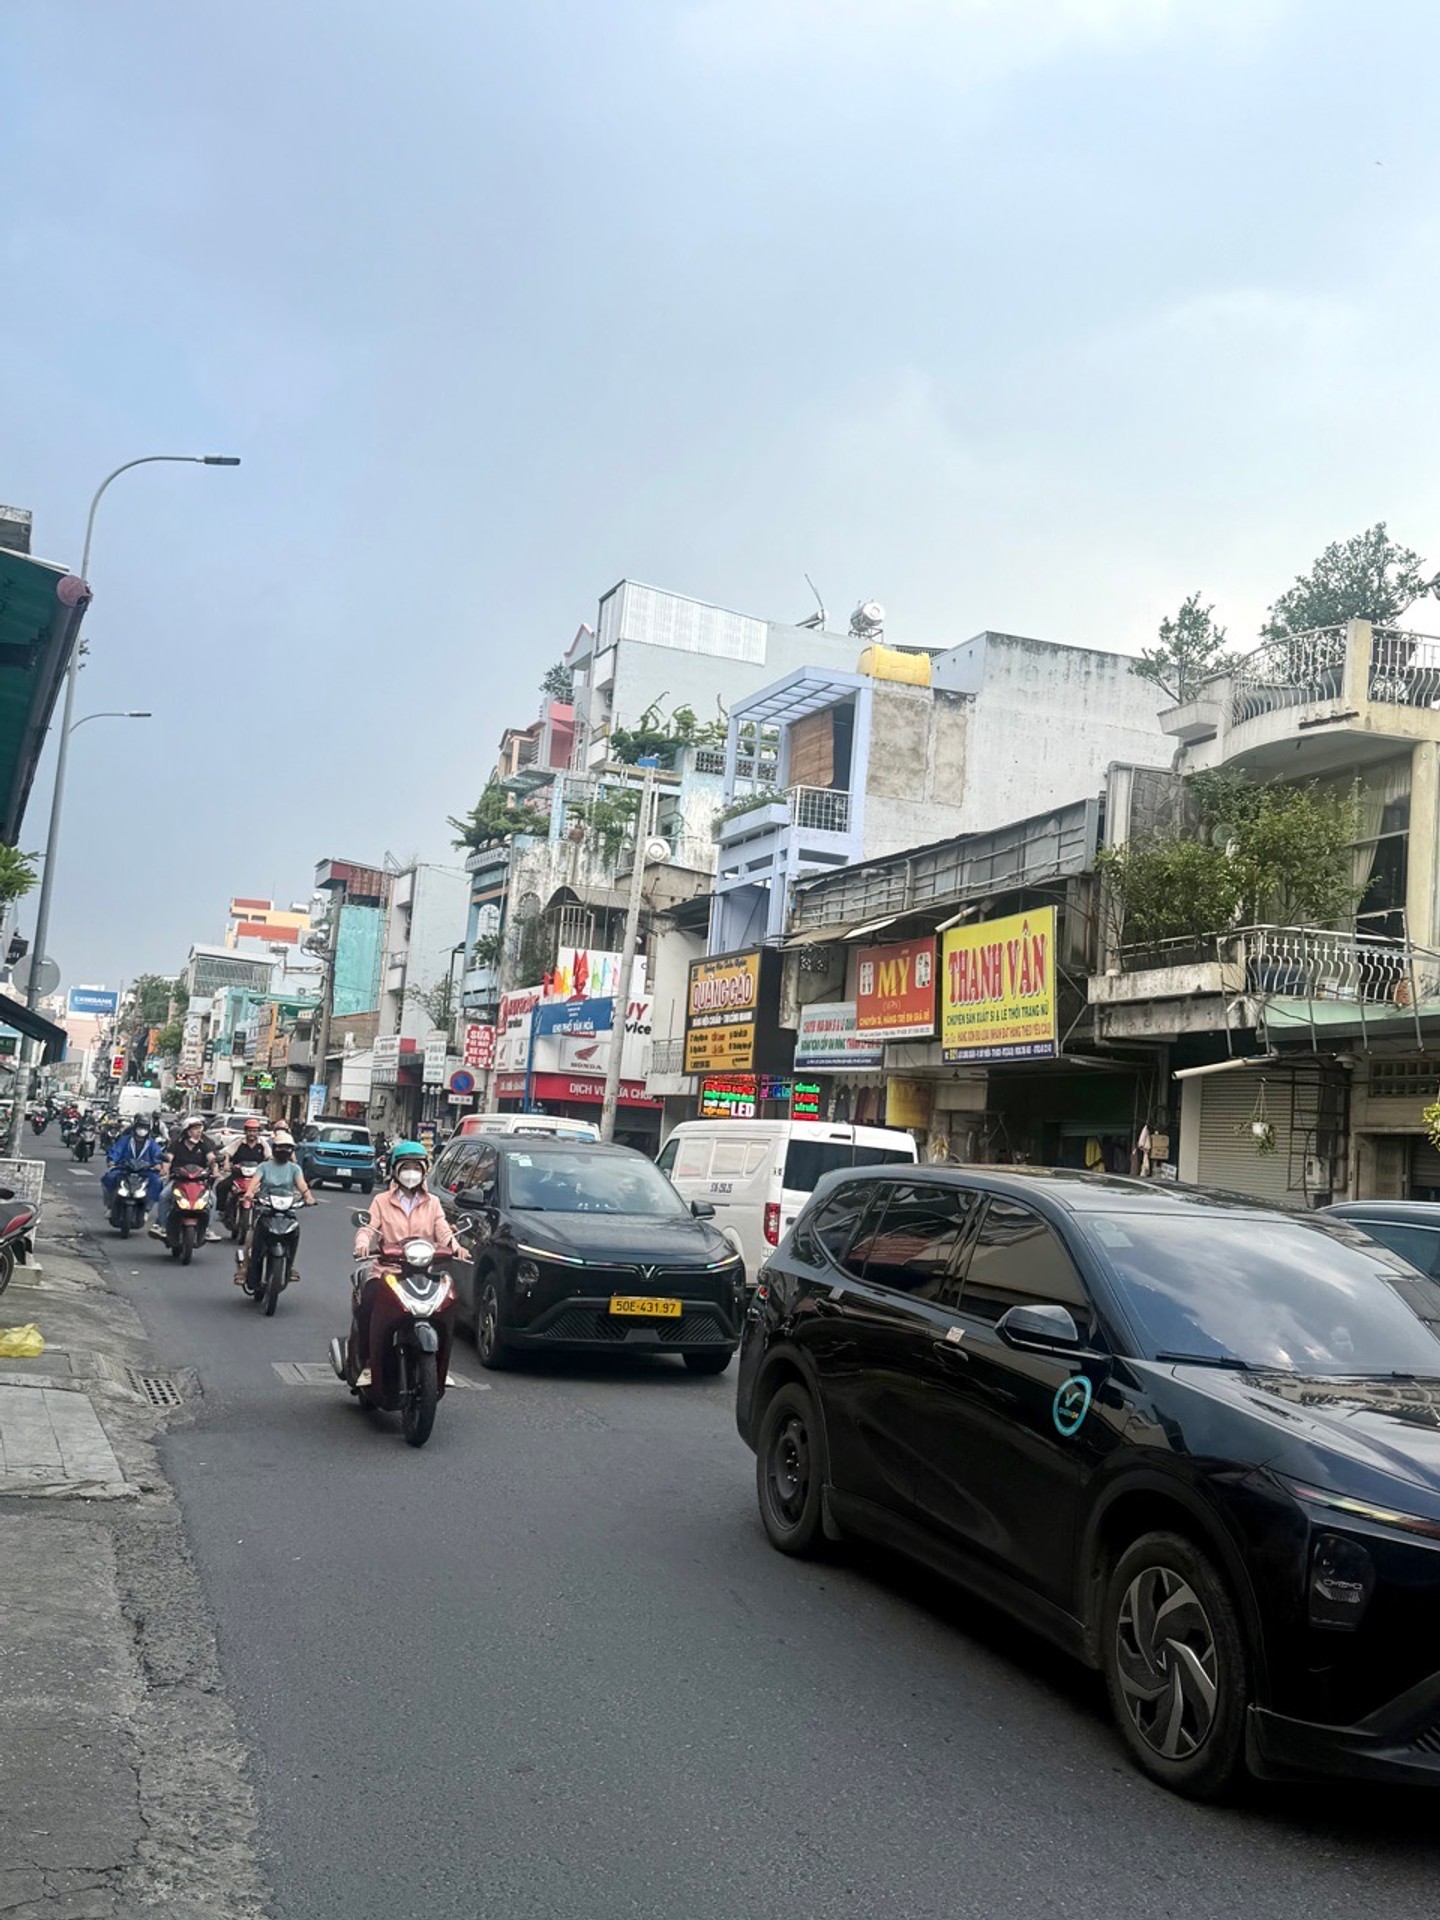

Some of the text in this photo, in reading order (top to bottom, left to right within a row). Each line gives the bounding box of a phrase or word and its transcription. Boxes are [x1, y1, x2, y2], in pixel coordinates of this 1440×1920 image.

[949, 919, 1047, 1007] THANH VÂN
[692, 973, 728, 1013] QUẢNG
[625, 1021, 652, 1035] vice
[570, 1062, 602, 1070] HONDA
[569, 1083, 592, 1096] DỊCH
[731, 1101, 755, 1118] LED
[616, 1300, 676, 1314] 50E-431.97
